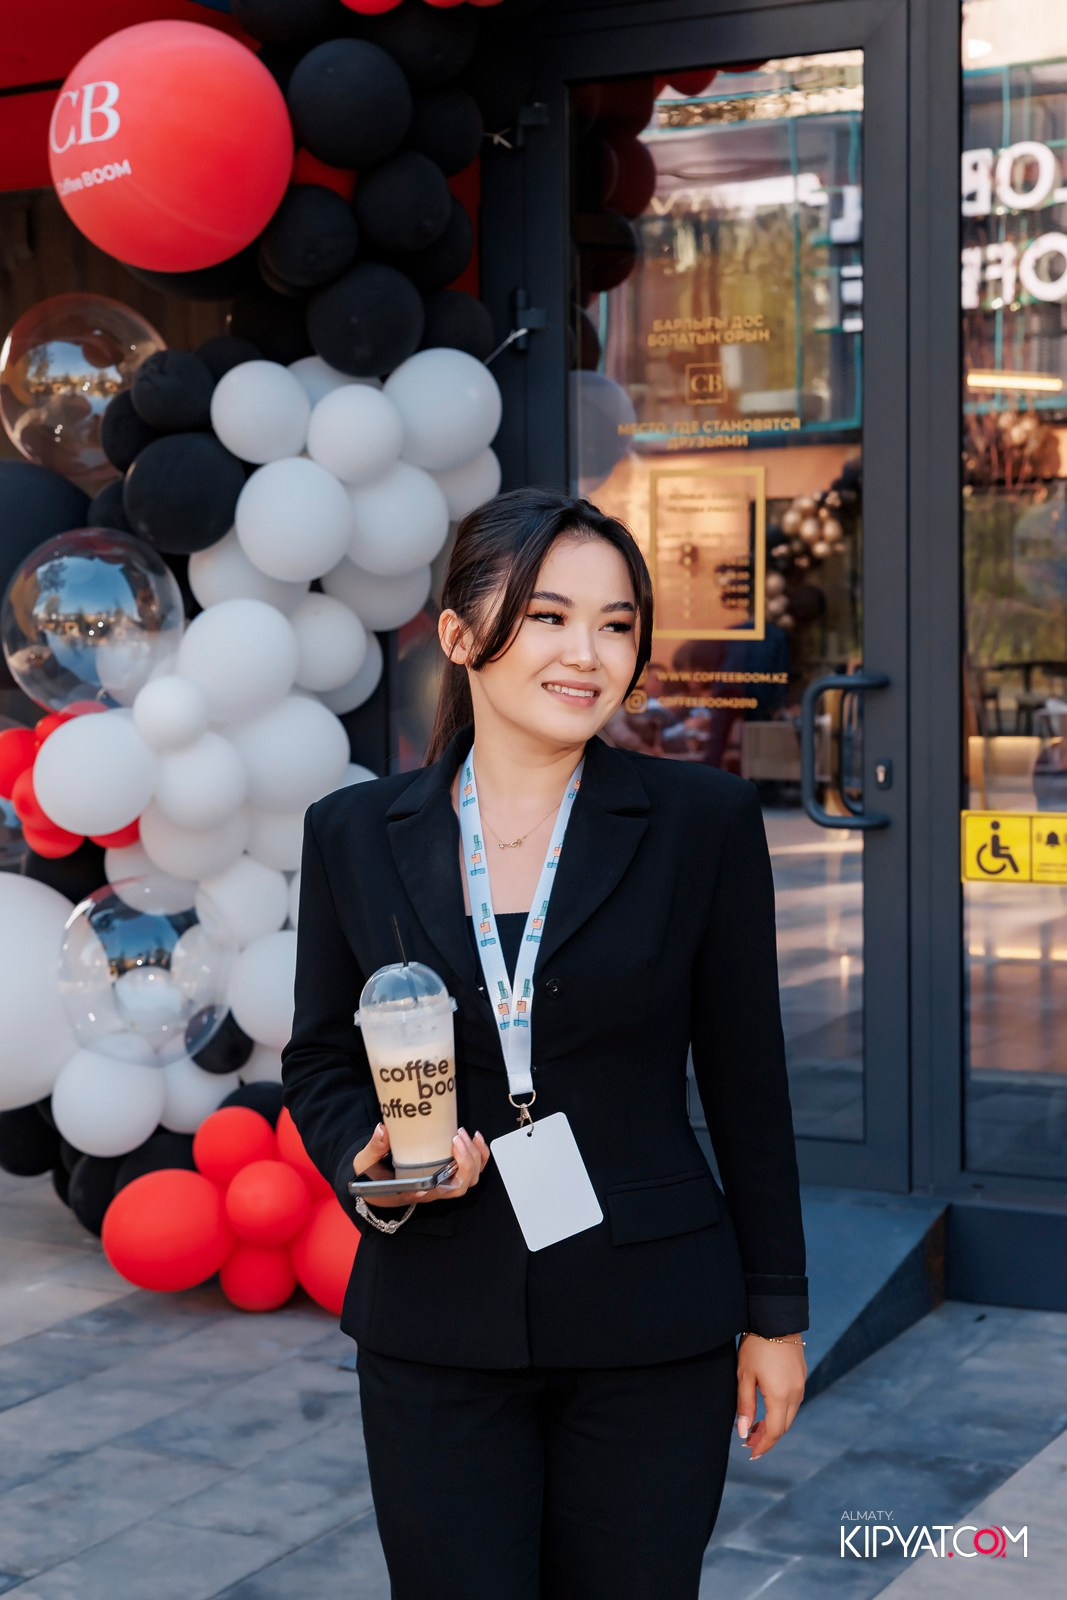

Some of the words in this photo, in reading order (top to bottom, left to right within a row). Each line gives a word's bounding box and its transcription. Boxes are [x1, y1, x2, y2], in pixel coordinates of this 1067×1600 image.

[50, 81, 120, 153] CB
[702, 417, 801, 433] СТАНОВЯТСЯ
[379, 1058, 449, 1083] coffee
[417, 1077, 455, 1100] boo
[382, 1098, 432, 1118] offee
